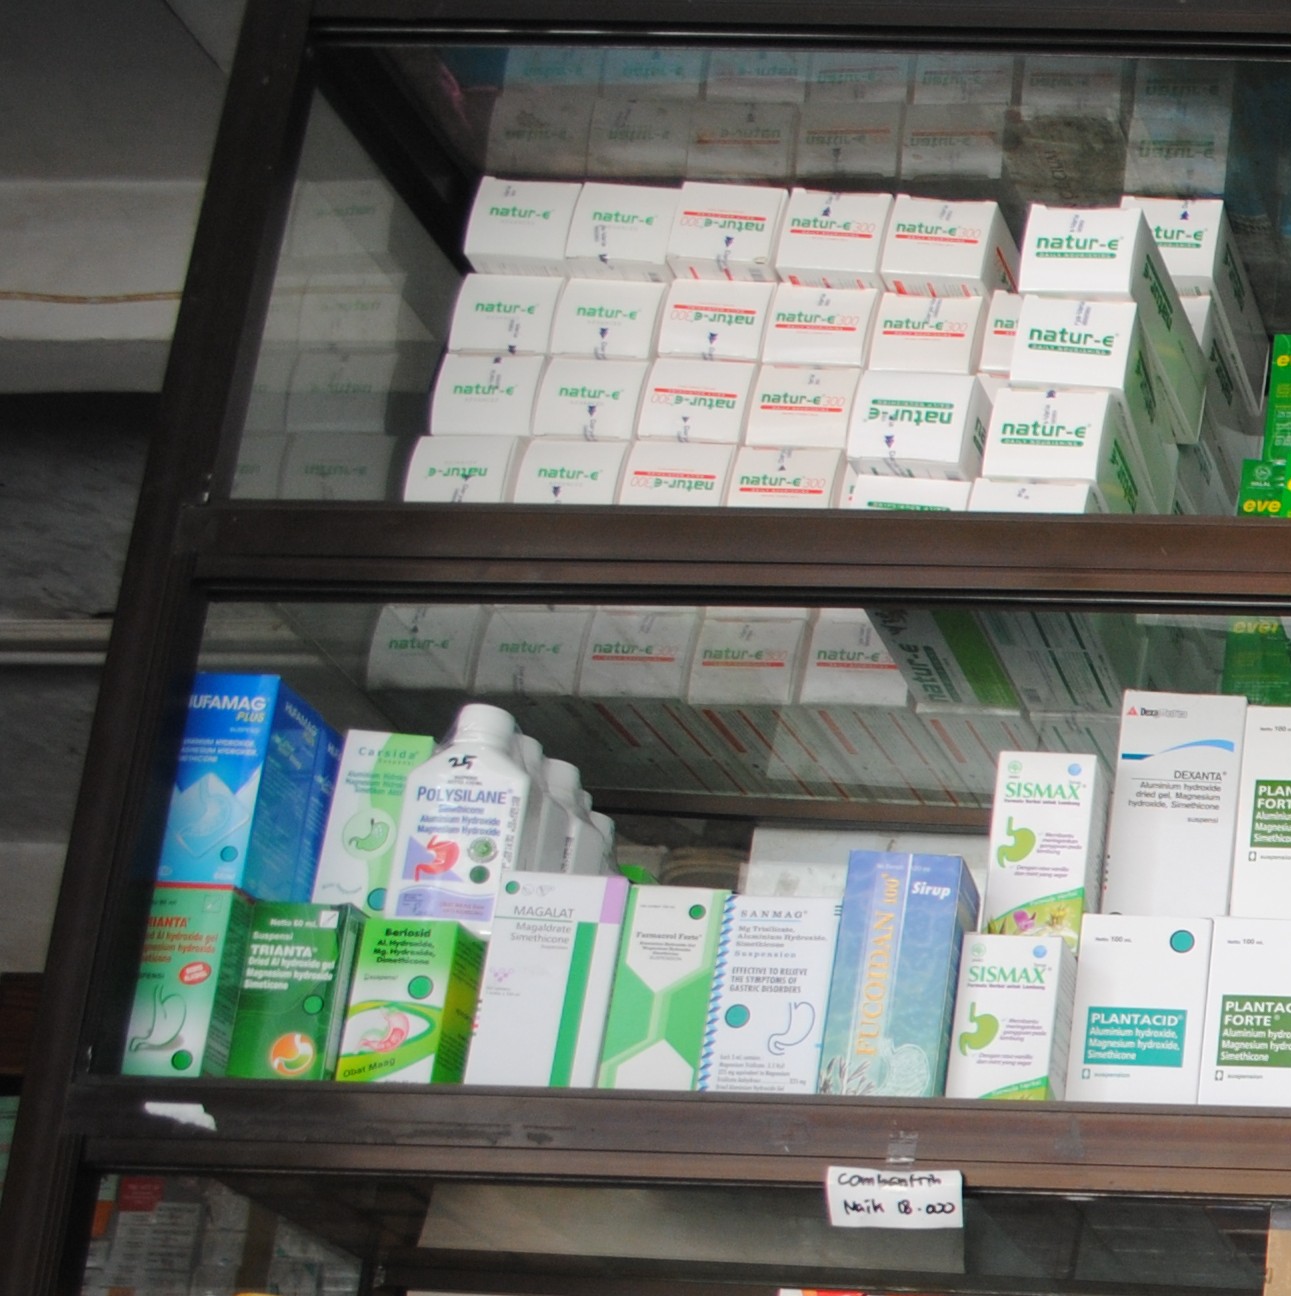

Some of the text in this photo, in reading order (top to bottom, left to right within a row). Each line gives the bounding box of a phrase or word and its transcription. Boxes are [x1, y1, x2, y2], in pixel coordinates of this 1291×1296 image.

[1036, 235, 1119, 251] natur-e
[236, 711, 266, 724] PLUS
[1173, 770, 1223, 782] DEXANTA
[417, 785, 507, 805] POLYSILANE
[1004, 781, 1081, 800] SISMAX
[514, 905, 575, 919] MAGALAT
[740, 909, 803, 919] SANMAG
[251, 944, 313, 961] TRIANTA
[1090, 1012, 1178, 1027] PLANTACID
